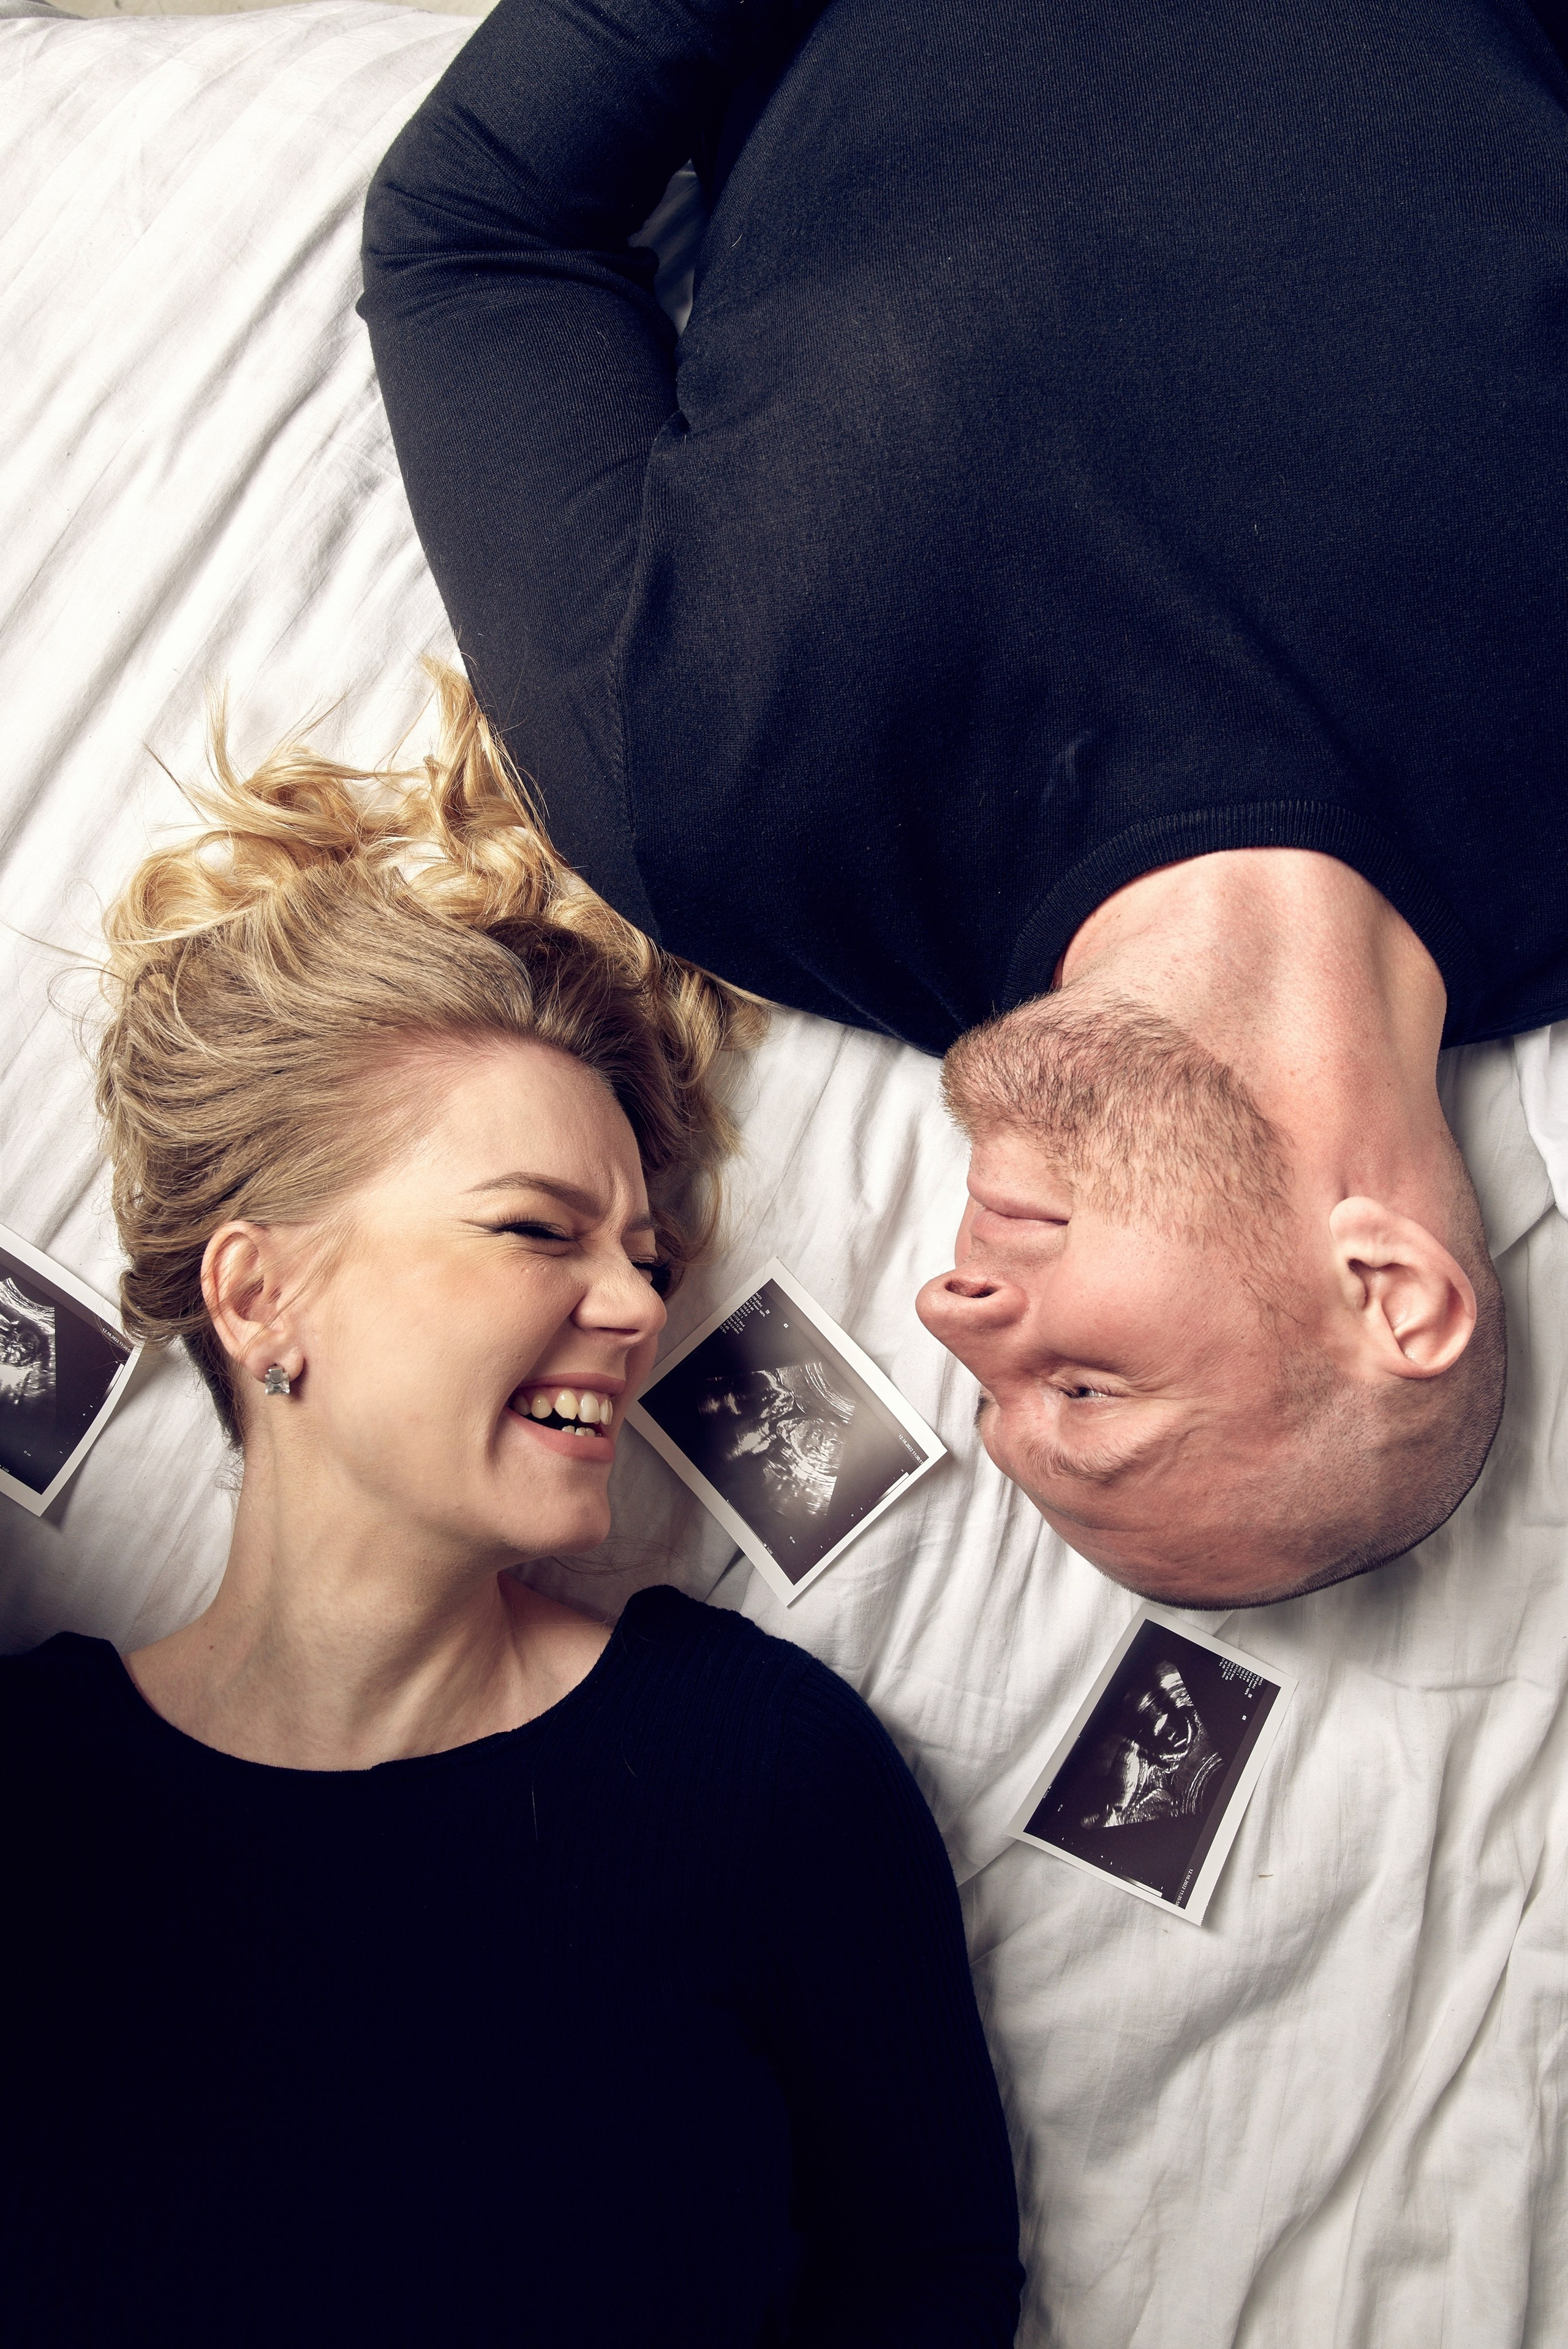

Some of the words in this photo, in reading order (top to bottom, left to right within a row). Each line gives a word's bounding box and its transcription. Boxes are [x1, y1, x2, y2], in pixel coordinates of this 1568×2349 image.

[102, 1328, 119, 1343] 12.10.2022
[898, 1434, 914, 1452] 12.10.2022
[911, 1451, 924, 1464] 11:30:11
[1182, 1869, 1193, 1889] 12.10.2022
